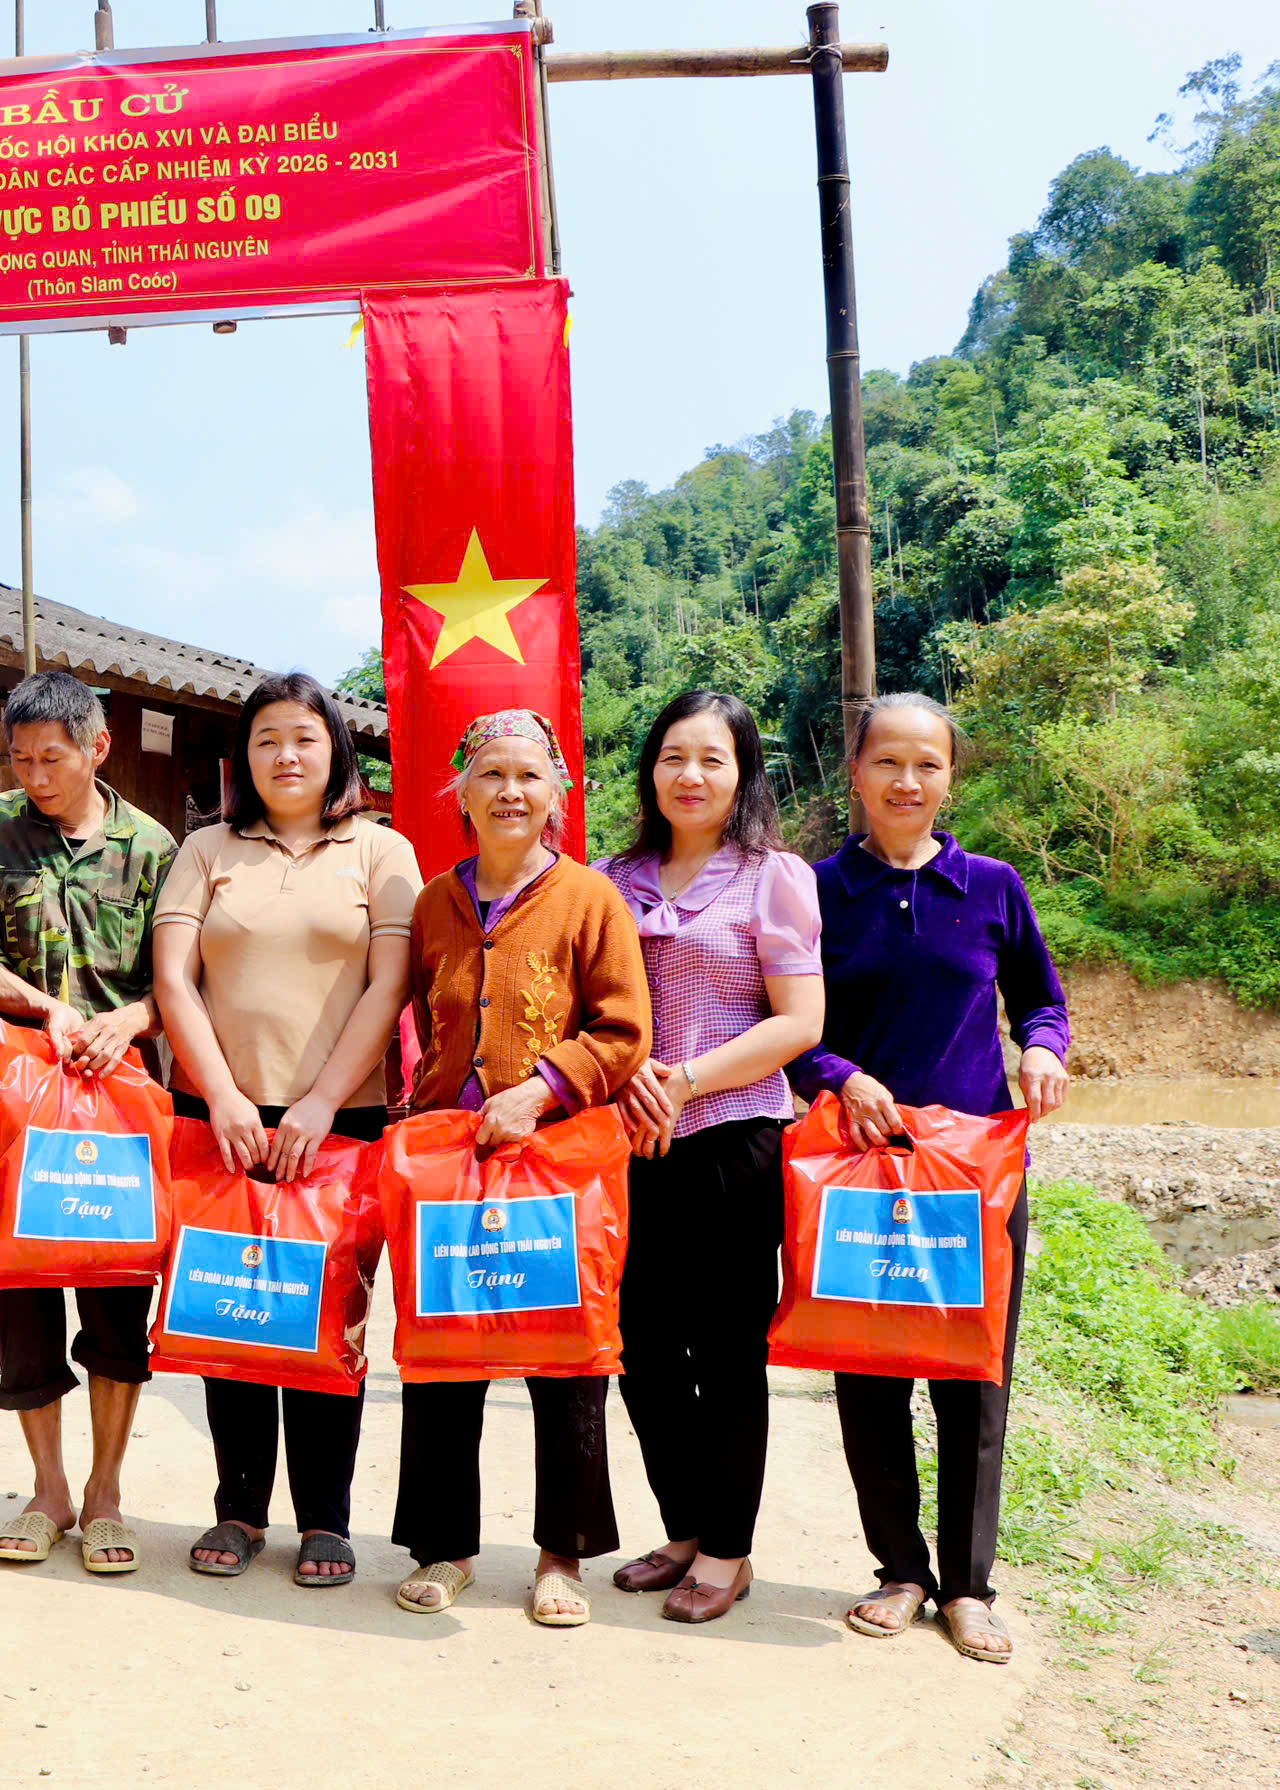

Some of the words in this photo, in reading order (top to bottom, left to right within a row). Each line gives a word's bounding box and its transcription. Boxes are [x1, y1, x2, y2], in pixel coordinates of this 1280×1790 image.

[0, 89, 104, 126] BẦU
[120, 83, 189, 116] CỬ
[37, 134, 76, 158] HỘI
[84, 128, 149, 152] KHÓA
[156, 128, 193, 148] XVI
[200, 122, 231, 145] VÀ
[238, 124, 277, 147] ĐẠI
[284, 112, 338, 141] BIỂU
[47, 163, 95, 187] CÁC
[102, 156, 150, 184] CẤP
[158, 155, 232, 181] NHIỆM
[240, 152, 270, 176] KỲ
[277, 153, 329, 174] 2026
[349, 150, 398, 170] 2031
[51, 196, 91, 232] BỎ
[100, 191, 187, 229] PHIẾU
[197, 186, 236, 223] SỐ
[245, 193, 281, 221] 09
[42, 249, 97, 268] QUAN,
[102, 240, 143, 264] TỈNH
[148, 239, 189, 262] THÁI
[194, 235, 269, 260] NGUYÊN
[27, 277, 76, 300] (Thôn
[81, 275, 123, 294] Slam
[128, 271, 178, 292] Coóc)
[61, 1198, 113, 1220] Tặng
[434, 1243, 449, 1258] LIÊN
[450, 1243, 468, 1257] ĐOÀN
[469, 1244, 480, 1257] LAO
[481, 1241, 499, 1257] ĐỘNG
[517, 1237, 533, 1252] THÁI
[836, 1228, 853, 1242] LIÊN
[853, 1230, 873, 1244] ĐOÀN
[874, 1233, 887, 1246] LAO
[920, 1235, 936, 1248] THÁI
[938, 1234, 968, 1248] NGUYÊN
[189, 1268, 203, 1282] LIÊN
[203, 1271, 220, 1285] ĐOÀN
[221, 1274, 233, 1287] LAO
[234, 1275, 252, 1290] ĐỘNG
[281, 1280, 310, 1296] NGUYÊN
[468, 1270, 527, 1290] Tặng
[870, 1259, 930, 1283] Tặng
[215, 1298, 271, 1325] Tặng
